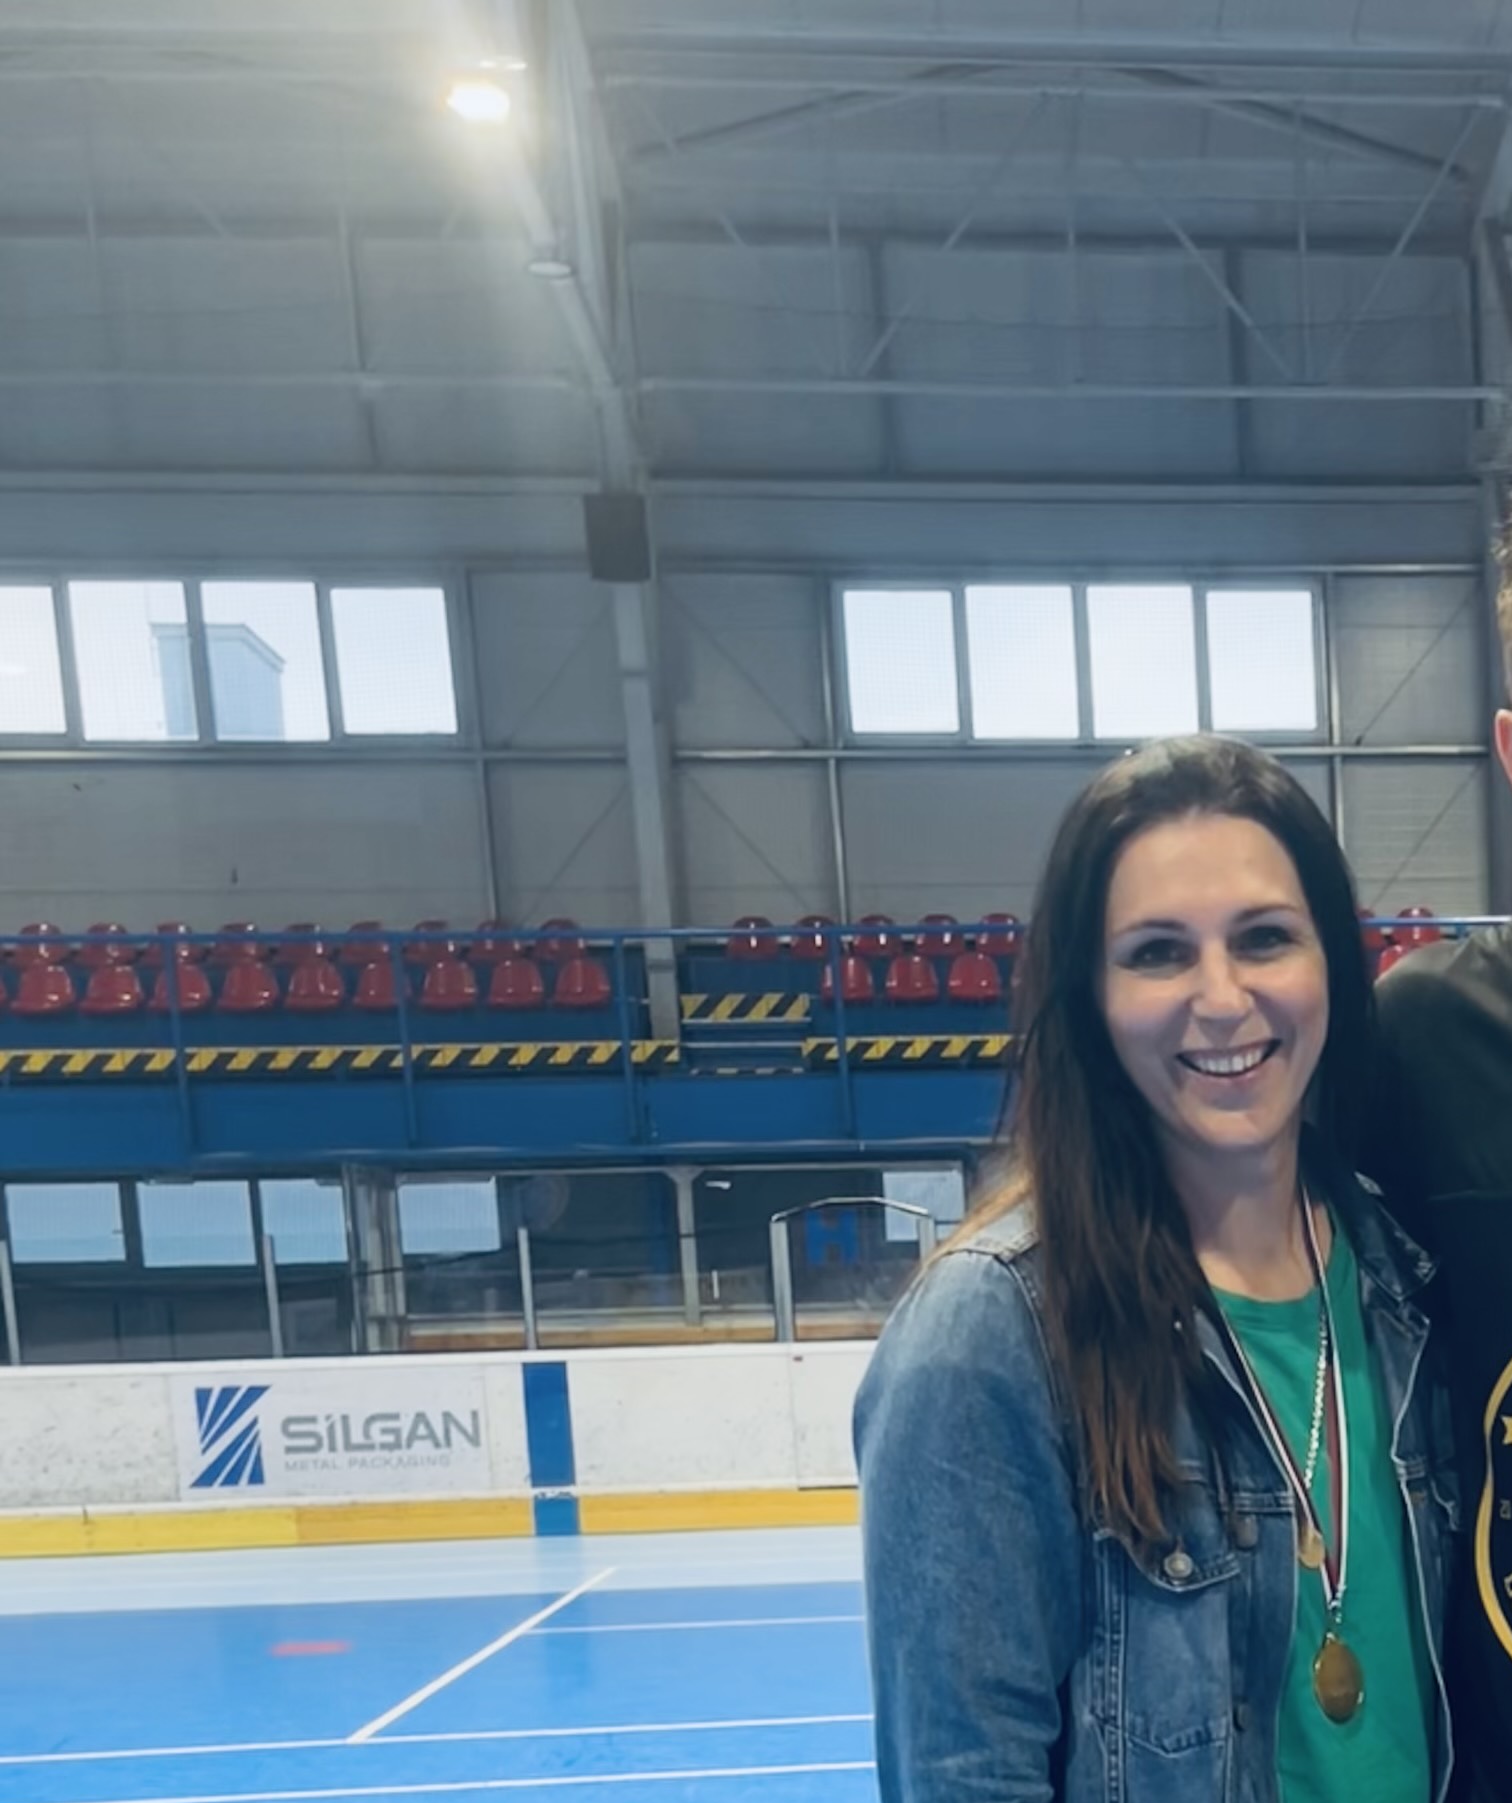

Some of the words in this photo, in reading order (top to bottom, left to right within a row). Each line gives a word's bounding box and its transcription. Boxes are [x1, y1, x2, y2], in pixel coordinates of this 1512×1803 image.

[281, 1409, 481, 1455] SILGAN
[284, 1458, 340, 1472] METAL
[348, 1453, 451, 1470] PACKAGING
